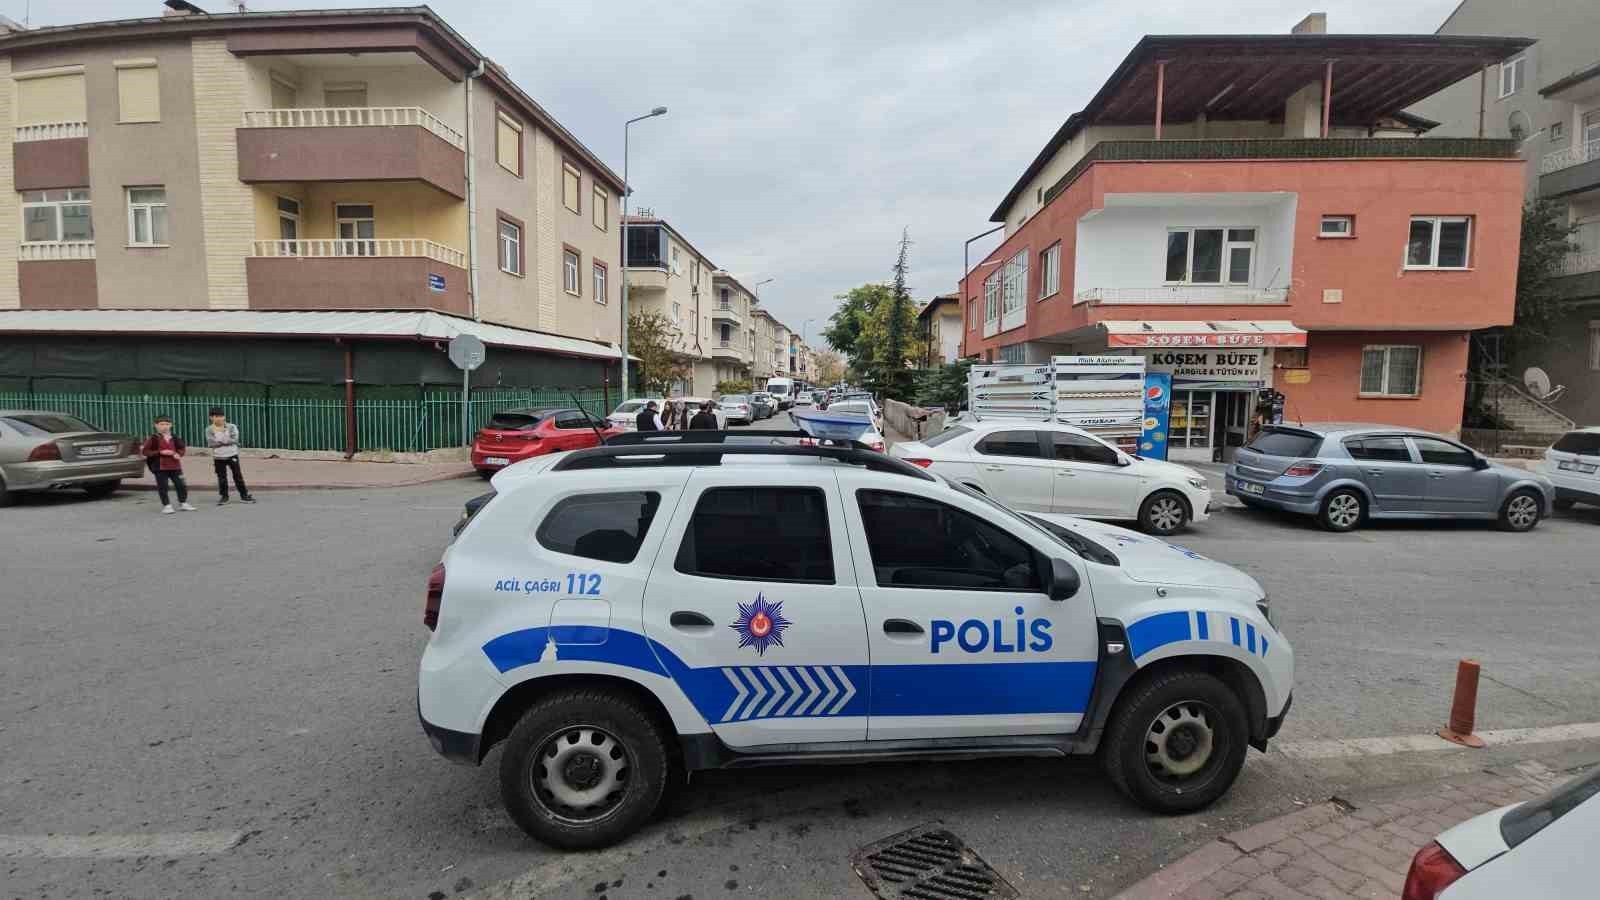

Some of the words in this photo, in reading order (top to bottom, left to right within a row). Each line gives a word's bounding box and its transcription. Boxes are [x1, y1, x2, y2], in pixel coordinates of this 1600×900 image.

[1152, 351, 1208, 367] KÖŞEM
[1216, 352, 1258, 366] BÜFE
[495, 577, 521, 592] ACİL
[524, 578, 561, 595] ÇAĞRI
[566, 573, 602, 595] 112
[931, 606, 1053, 653] POLİS
